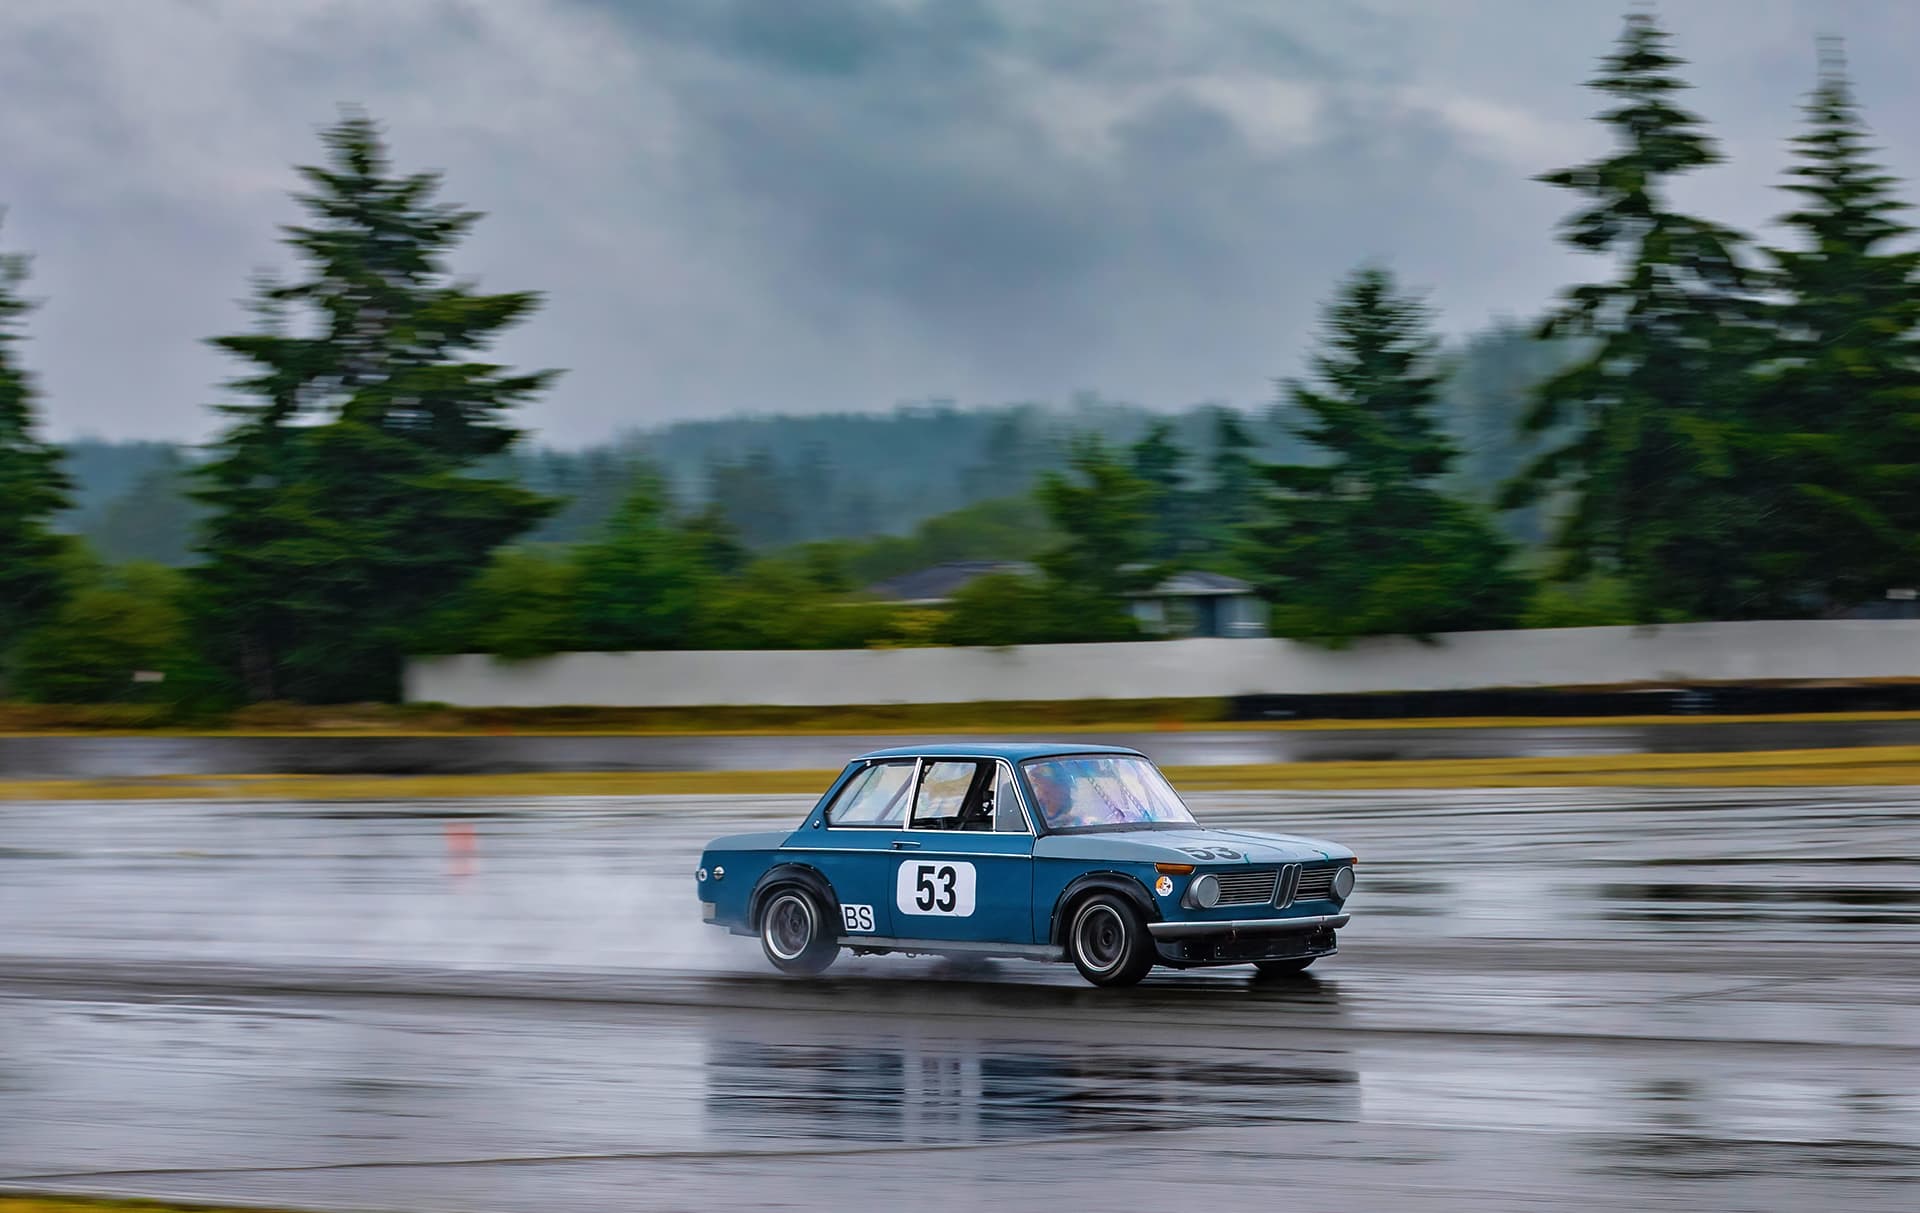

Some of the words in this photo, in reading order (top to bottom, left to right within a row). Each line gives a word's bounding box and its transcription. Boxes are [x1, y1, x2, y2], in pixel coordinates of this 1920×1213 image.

[1174, 846, 1242, 860] 53
[915, 865, 957, 912] 53
[844, 906, 873, 930] BS
